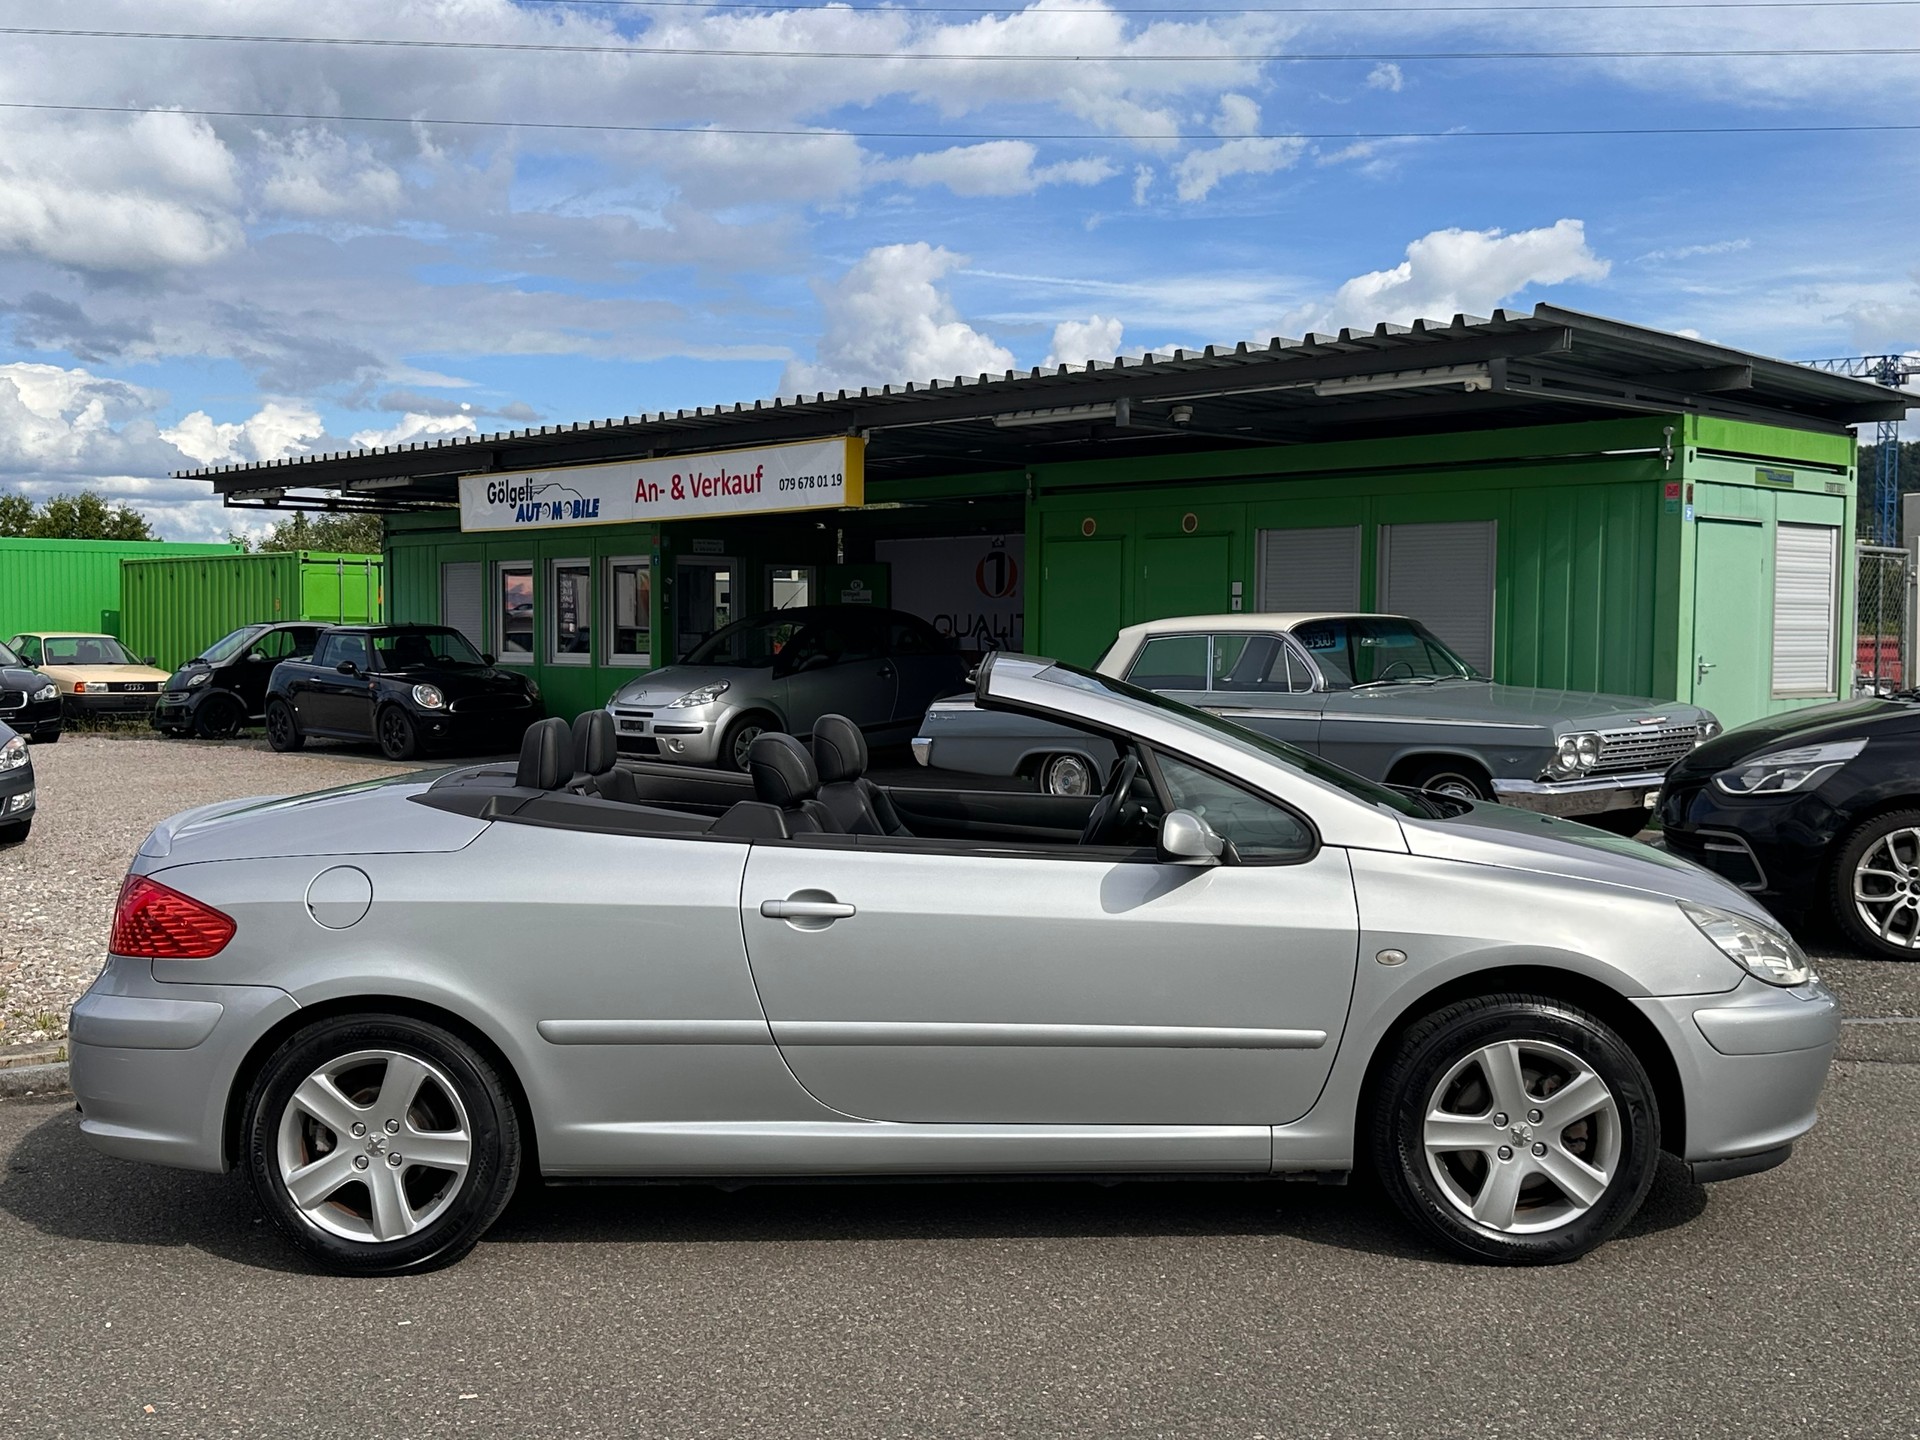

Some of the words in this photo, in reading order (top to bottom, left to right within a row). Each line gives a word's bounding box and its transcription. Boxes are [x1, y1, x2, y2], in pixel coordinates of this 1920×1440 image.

[487, 477, 533, 509] Gölgeli
[635, 478, 666, 503] An-
[671, 474, 686, 500] &
[689, 464, 763, 498] Verkauf
[779, 476, 797, 492] 079
[798, 475, 815, 490] 678
[817, 474, 829, 488] 01
[831, 472, 843, 486] 19
